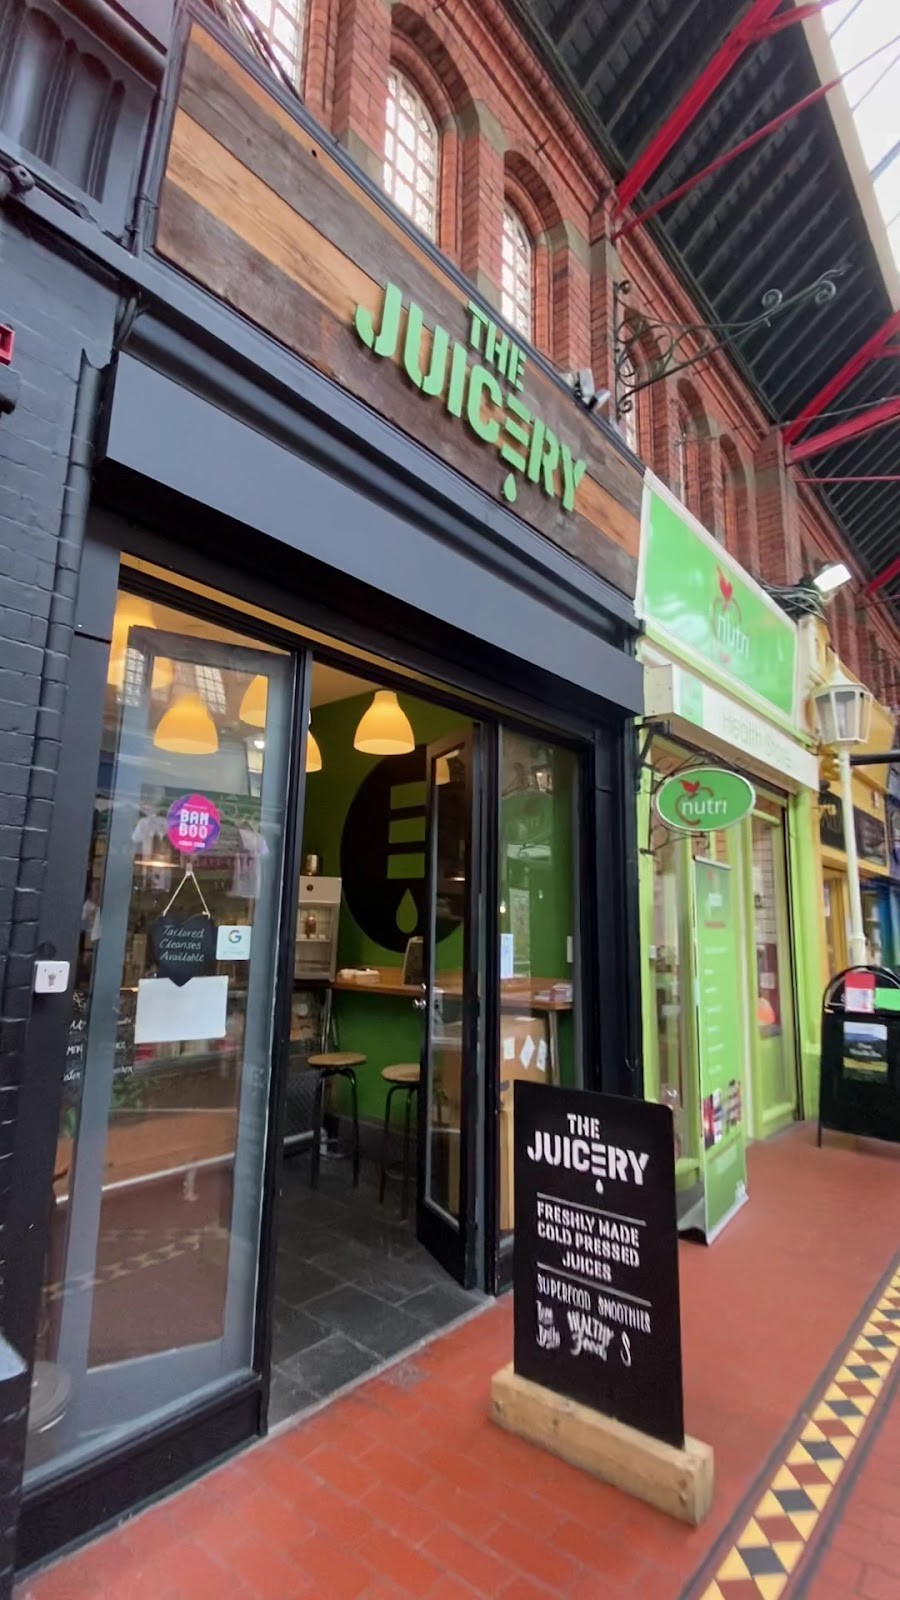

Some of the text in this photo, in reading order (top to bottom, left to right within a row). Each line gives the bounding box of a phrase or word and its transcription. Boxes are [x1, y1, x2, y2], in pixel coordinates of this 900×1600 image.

[468, 300, 527, 392] THE
[355, 281, 586, 512] JUICERY
[180, 809, 209, 826] BAM
[682, 797, 727, 815] nutri
[178, 823, 208, 840] BOO
[159, 938, 201, 950] Cleanses
[162, 924, 204, 938] Tailored
[159, 950, 204, 963] Available
[567, 1113, 600, 1139] THE
[527, 1131, 649, 1185] JUICERY
[536, 1201, 639, 1248] FRESHLY MADE
[537, 1221, 639, 1267] COLD PRESSED
[562, 1251, 612, 1282] JUICES
[536, 1273, 591, 1311] SUPERFOOD
[597, 1295, 651, 1334] SMOOTHIES
